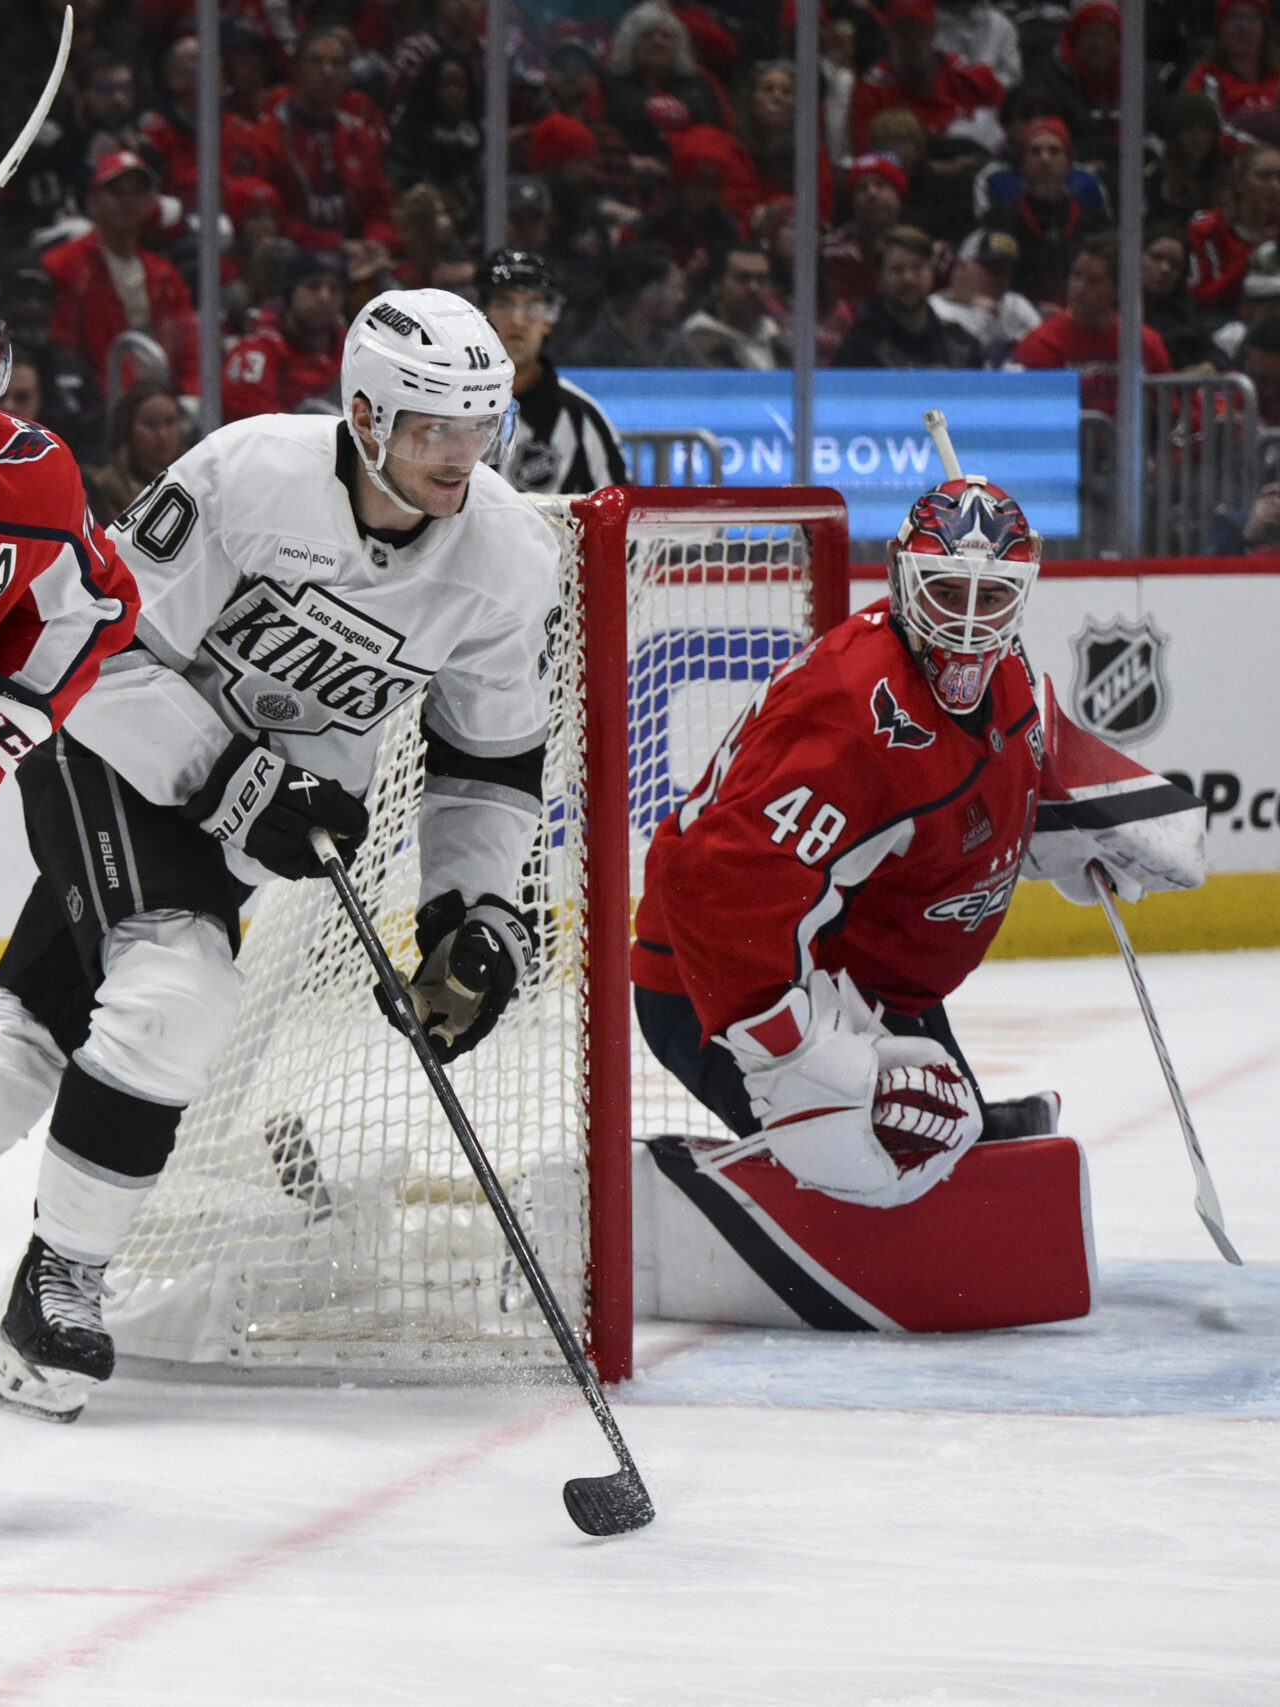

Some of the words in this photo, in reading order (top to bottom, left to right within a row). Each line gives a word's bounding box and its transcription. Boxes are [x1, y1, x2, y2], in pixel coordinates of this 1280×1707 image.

[369, 301, 421, 337] KINGS
[464, 345, 490, 370] 10
[812, 436, 935, 475] BOW
[278, 546, 308, 561] IRON
[312, 554, 336, 568] BOW
[306, 603, 331, 627] Los
[328, 619, 383, 655] Angeles
[215, 597, 416, 721] KINGS
[939, 661, 983, 704] 48
[1092, 651, 1149, 719] NHL
[762, 785, 847, 867] 48
